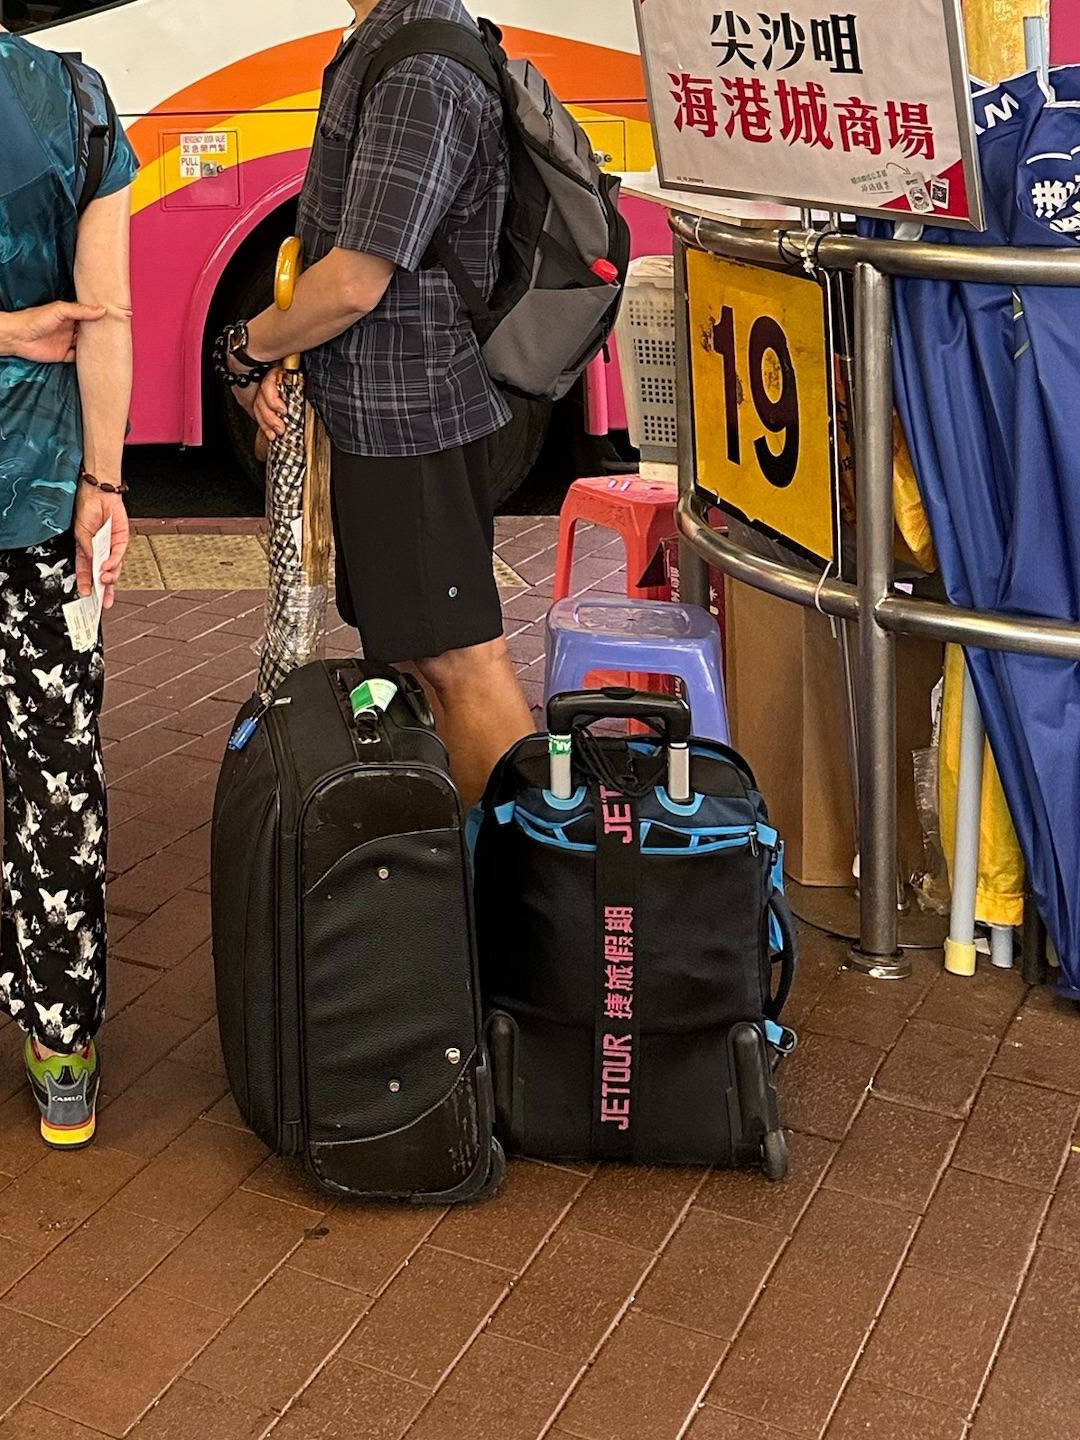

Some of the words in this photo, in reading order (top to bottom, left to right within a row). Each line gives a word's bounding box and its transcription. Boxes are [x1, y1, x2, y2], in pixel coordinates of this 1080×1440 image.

[709, 10, 864, 74] 尖沙咀
[181, 157, 199, 166] PULL
[667, 72, 935, 160] 海港城商場
[712, 305, 800, 489] 19
[604, 906, 633, 1020] 捷旅假期
[601, 1033, 632, 1131] JETOUR
